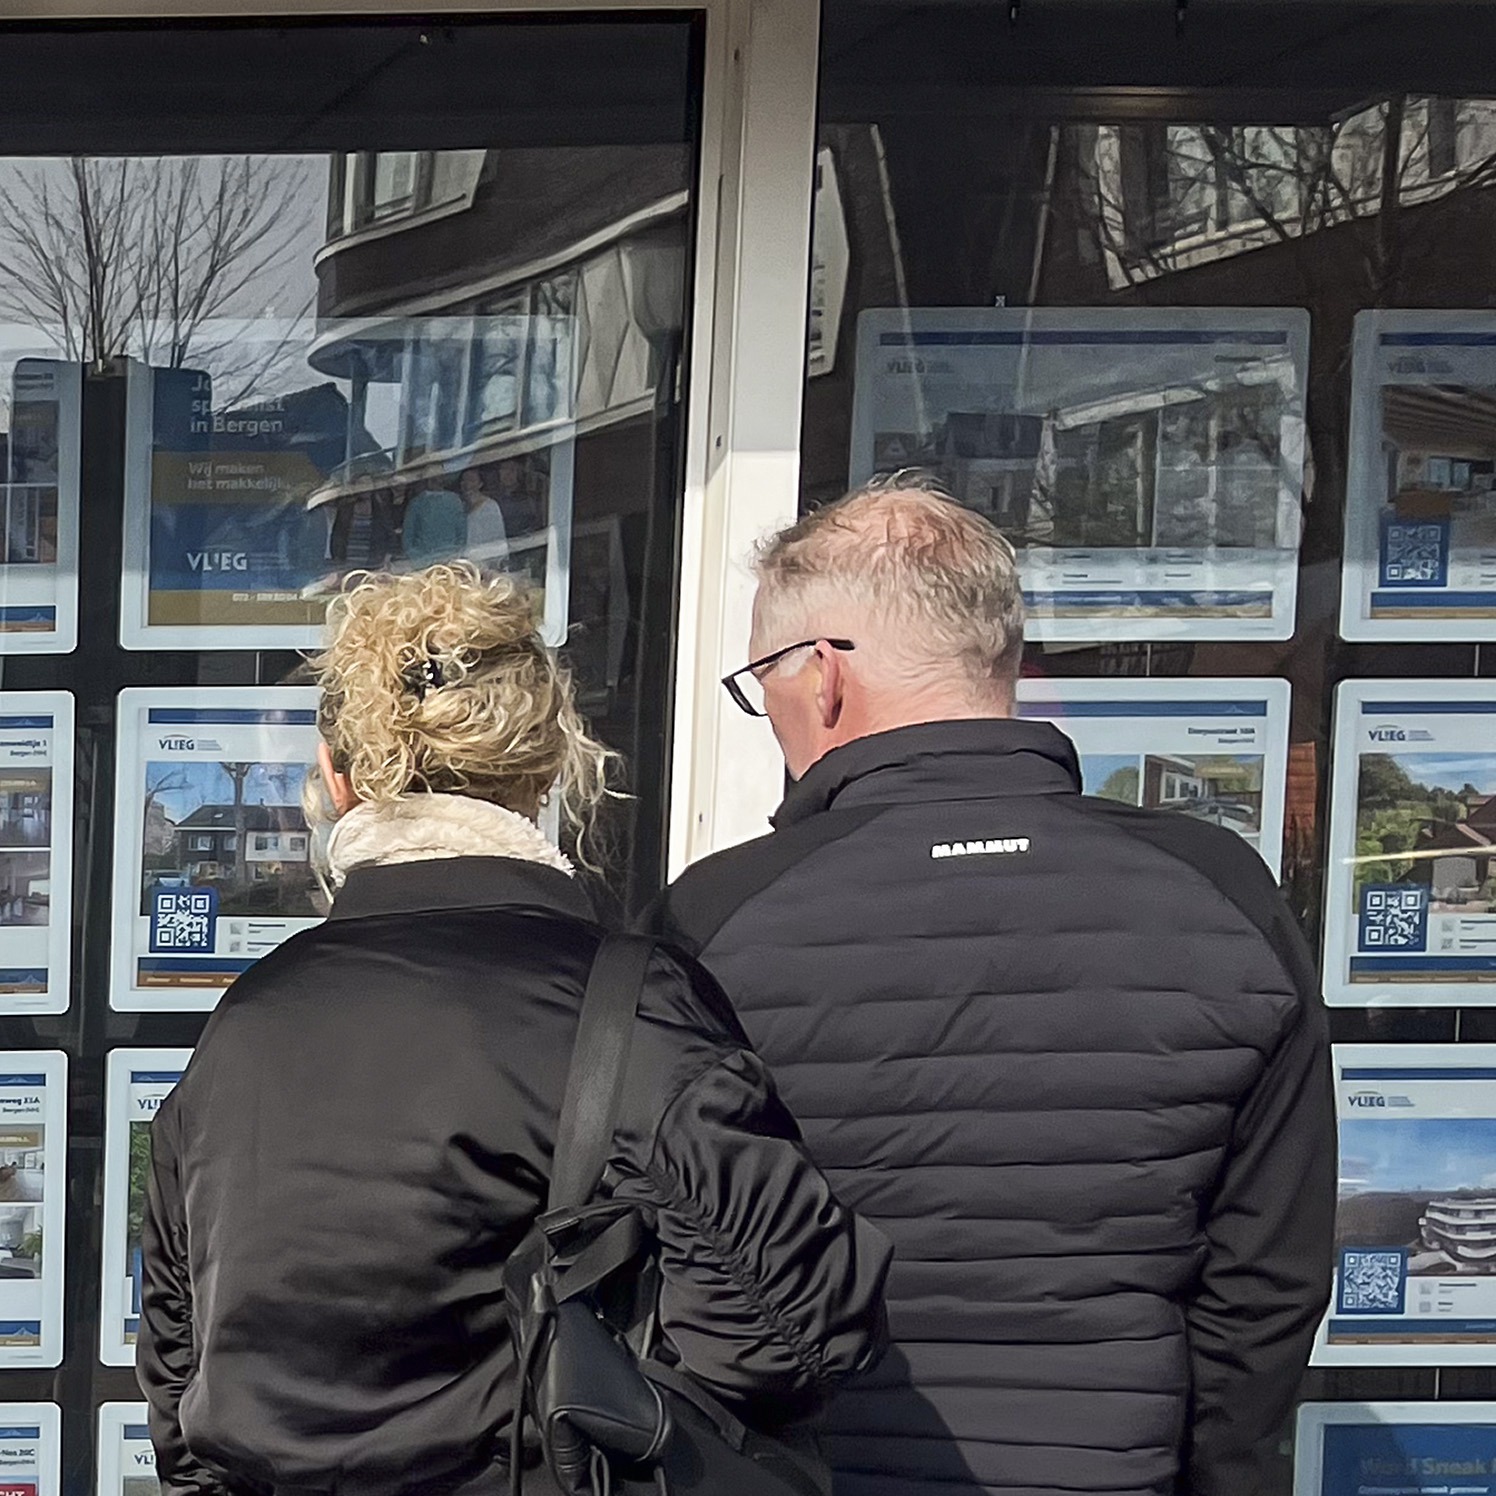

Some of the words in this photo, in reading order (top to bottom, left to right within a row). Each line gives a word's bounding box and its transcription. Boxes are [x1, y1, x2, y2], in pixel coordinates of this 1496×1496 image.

[213, 416, 283, 437] Bergen
[187, 552, 247, 571] VLIEG
[1369, 730, 1406, 742] VLIEG
[159, 739, 195, 751] VLIEG
[931, 838, 1029, 858] MAMMUT
[1349, 1095, 1385, 1107] VLIEG
